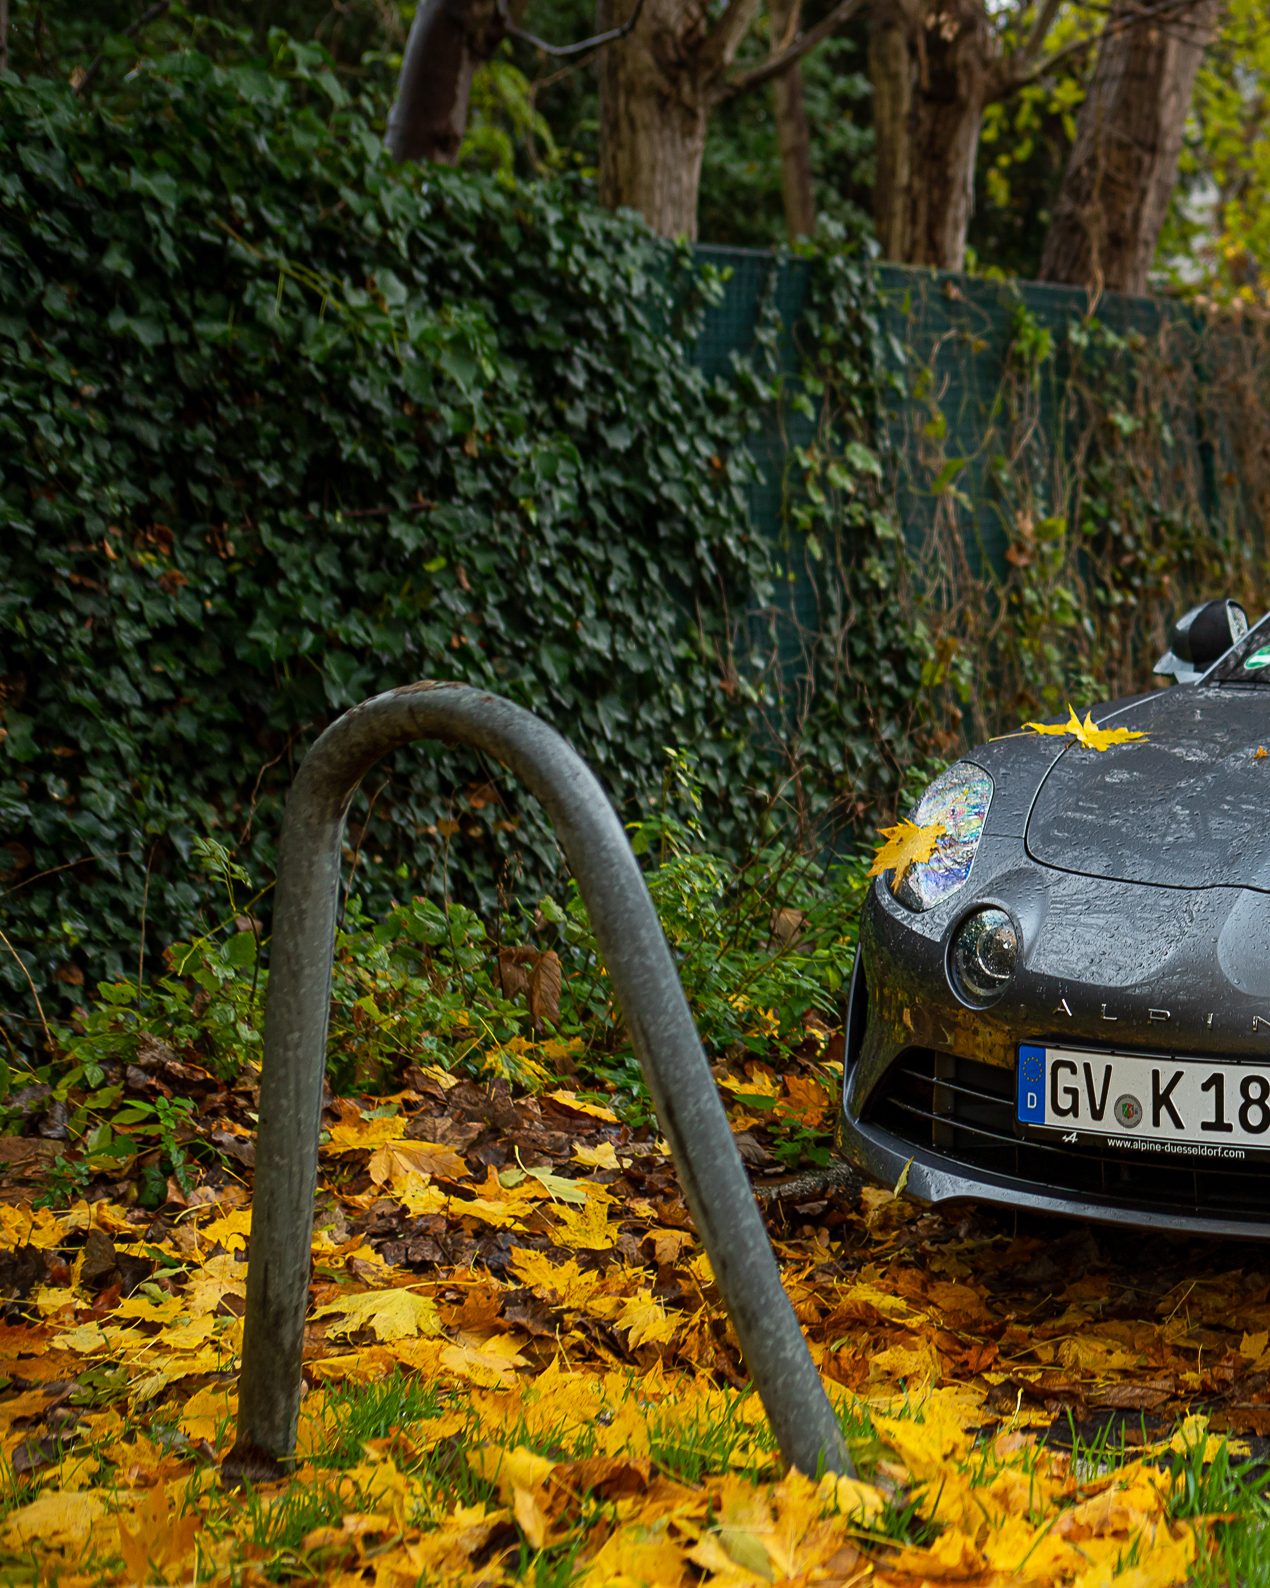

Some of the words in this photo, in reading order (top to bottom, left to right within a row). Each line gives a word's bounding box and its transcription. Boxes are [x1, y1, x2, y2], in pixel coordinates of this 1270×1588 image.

[1027, 1092, 1037, 1109] D
[1050, 1059, 1113, 1121] GV
[1151, 1068, 1185, 1130] K
[1107, 1137, 1246, 1160] www.alpine-duesseldorf.com
